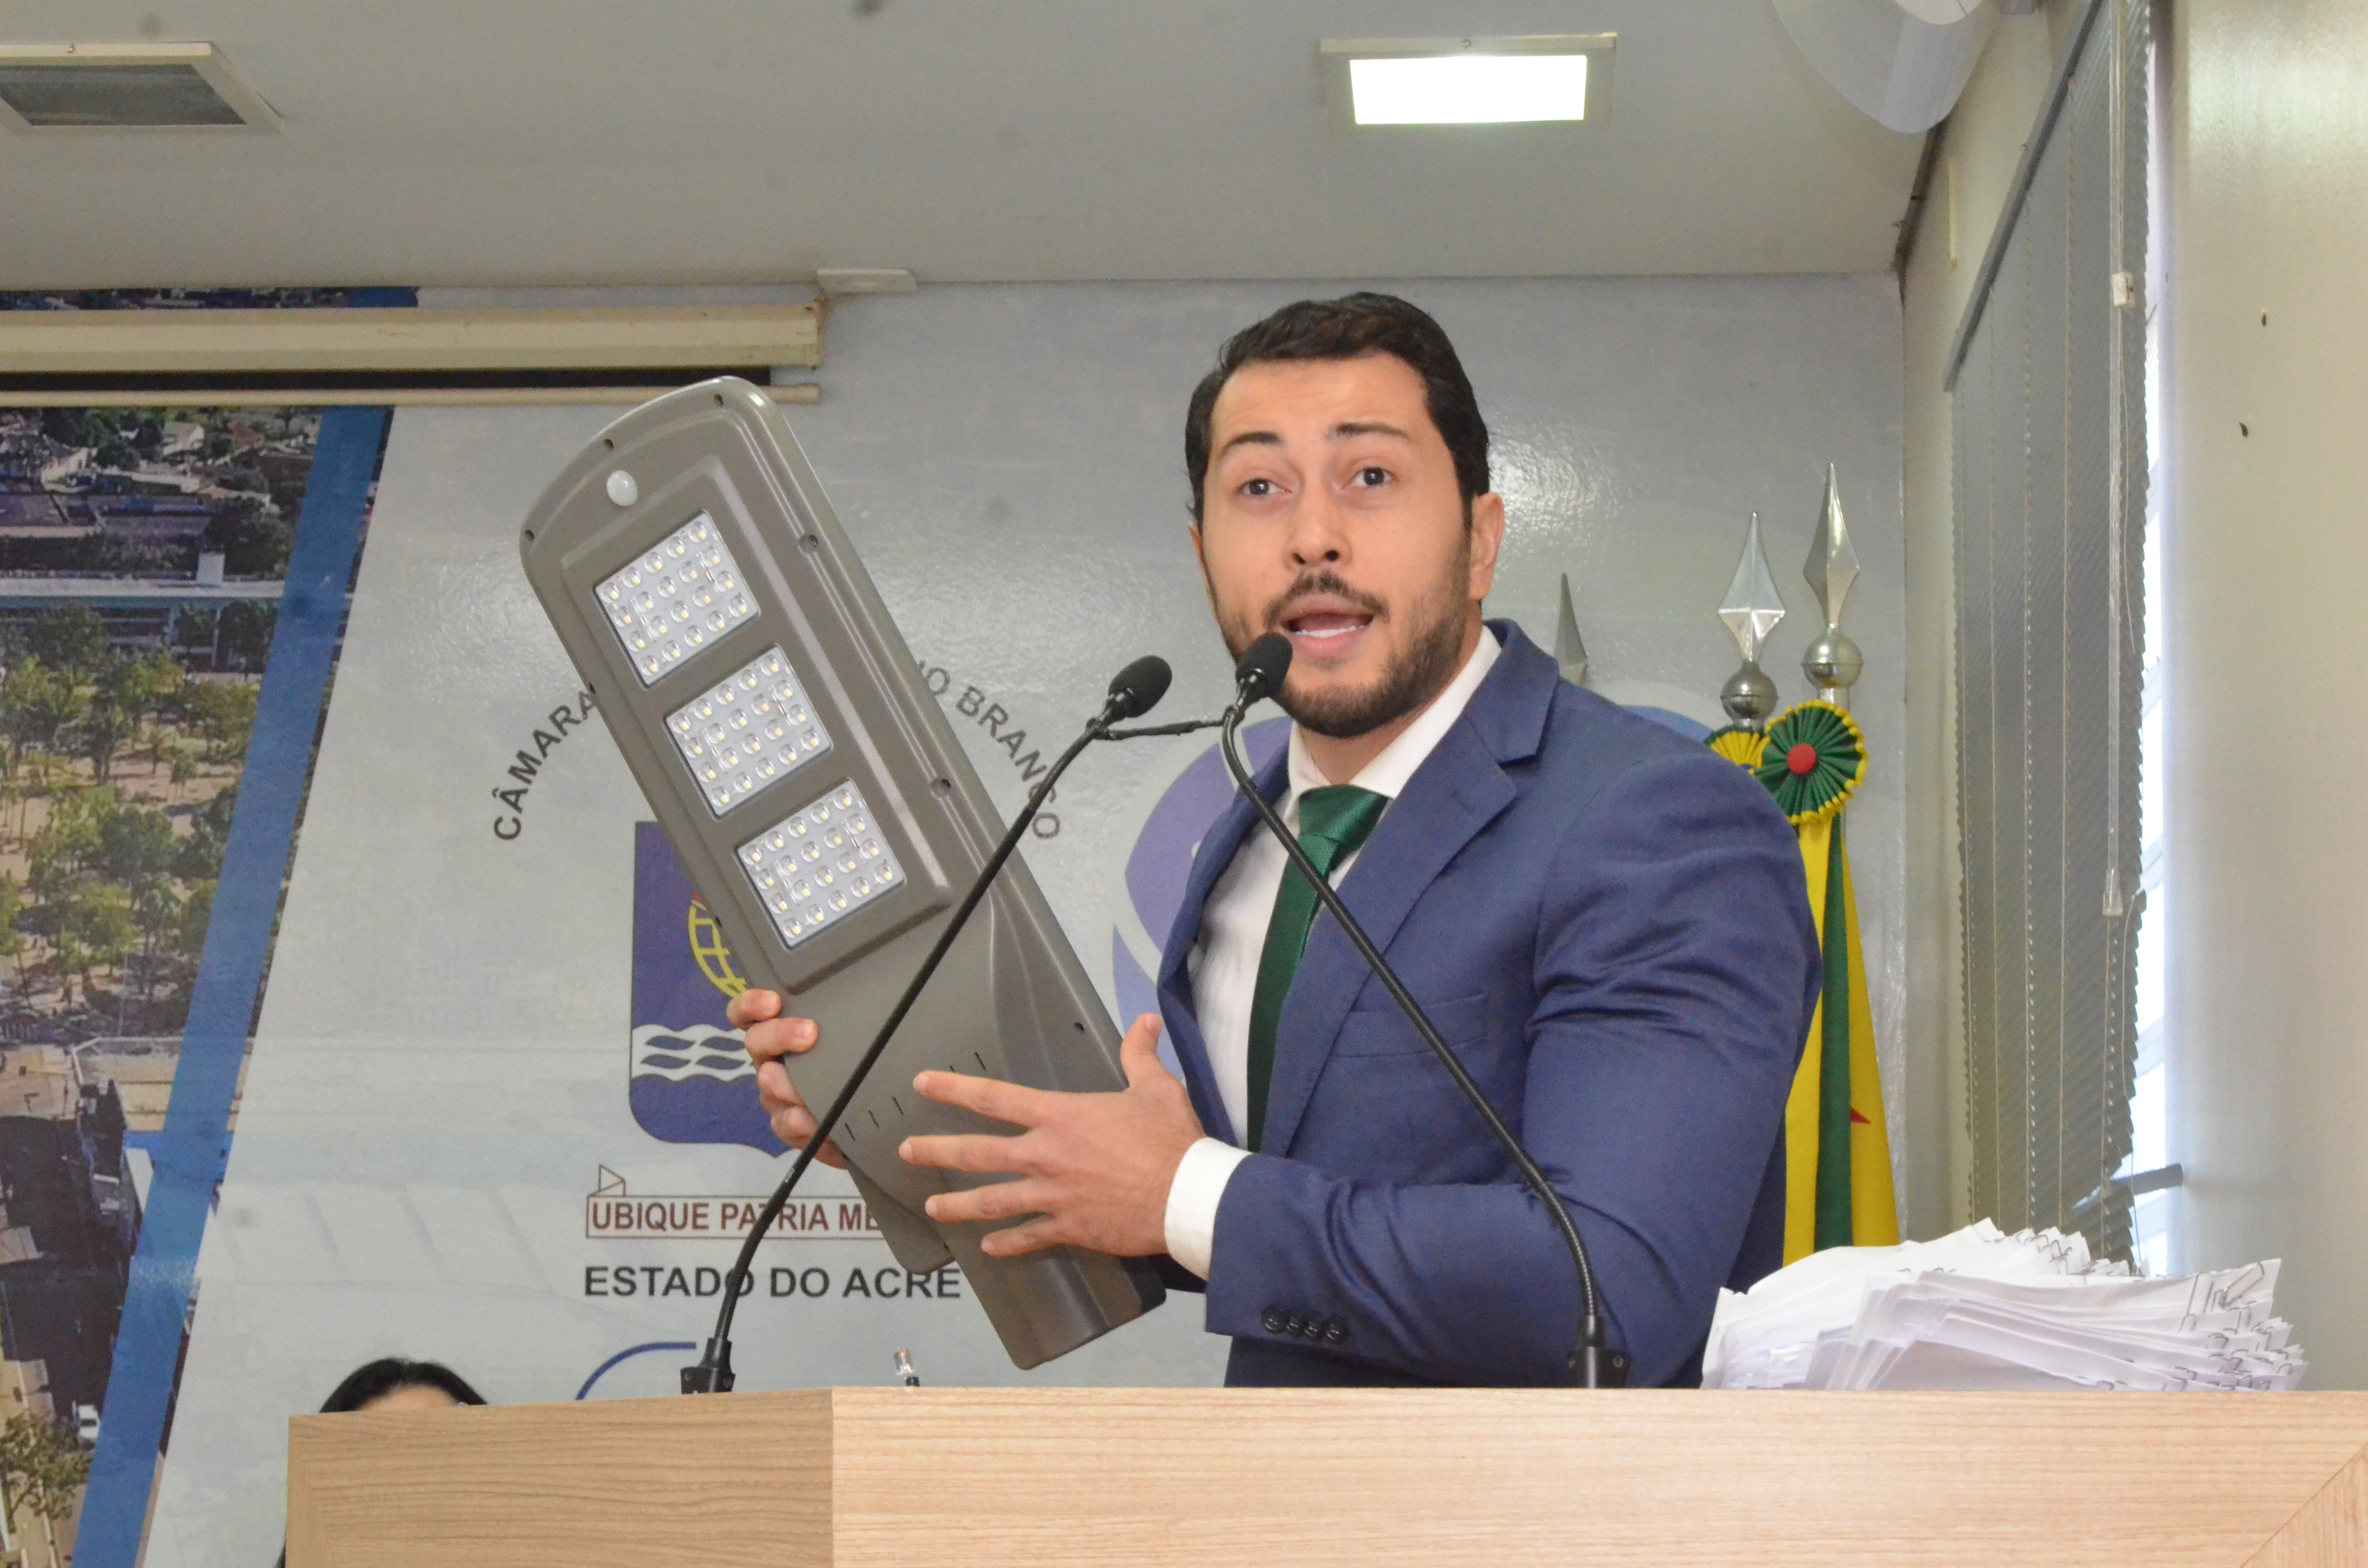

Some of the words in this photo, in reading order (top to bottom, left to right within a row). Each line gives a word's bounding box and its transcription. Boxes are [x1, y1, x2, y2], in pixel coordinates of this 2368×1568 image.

[592, 1202, 709, 1232] UBIQUE
[770, 1266, 830, 1298] DO
[842, 1266, 961, 1298] ACRE
